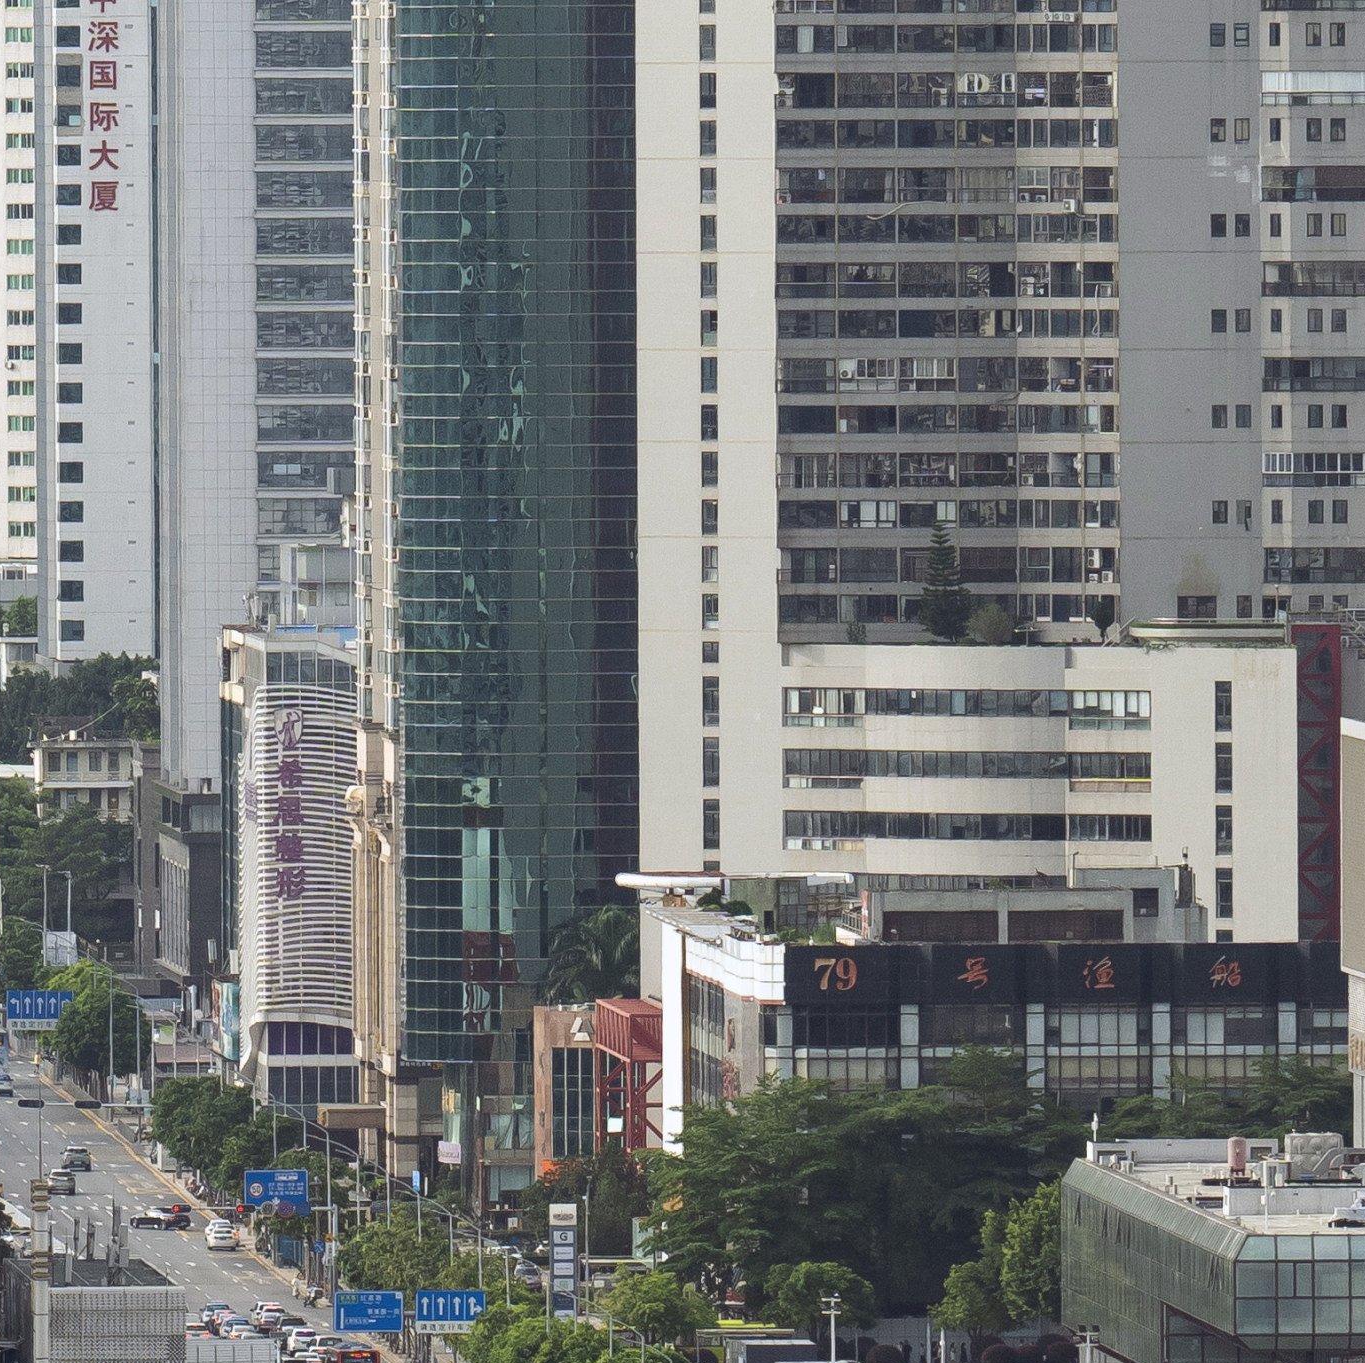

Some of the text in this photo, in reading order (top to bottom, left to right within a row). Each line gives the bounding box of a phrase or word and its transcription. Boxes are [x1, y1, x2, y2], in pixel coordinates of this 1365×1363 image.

[11, 1021, 58, 1029] 请选定行车
